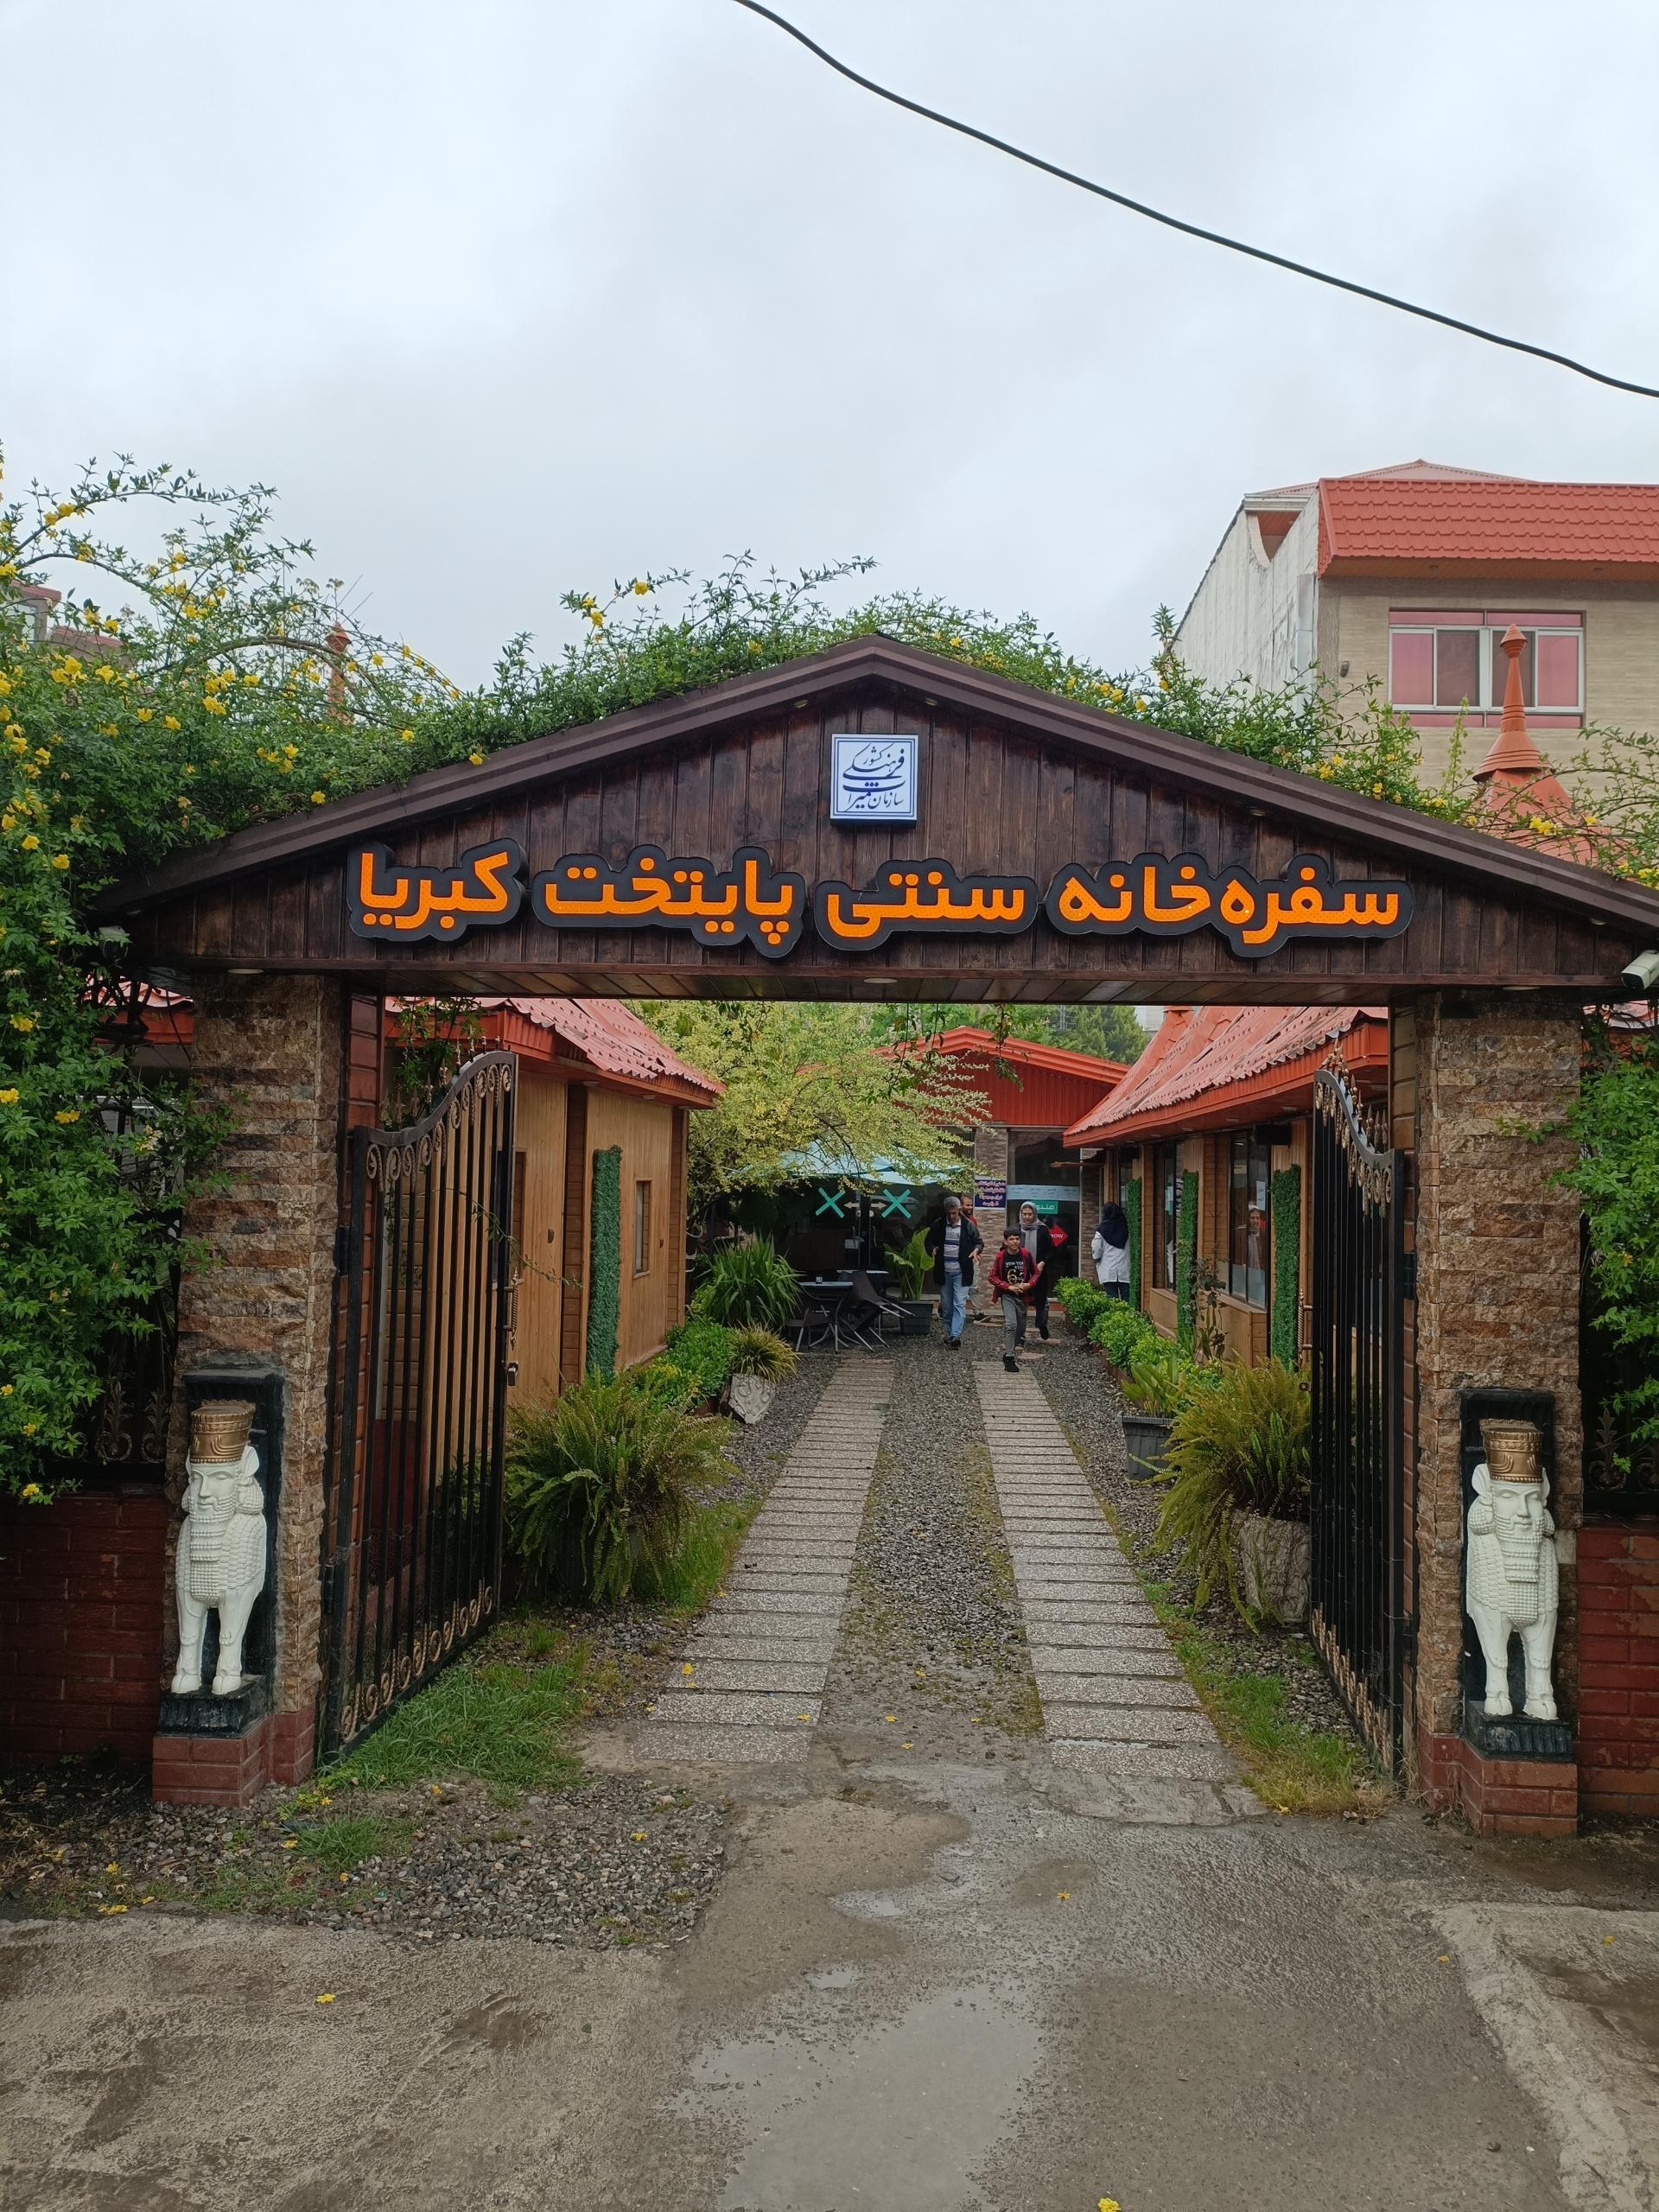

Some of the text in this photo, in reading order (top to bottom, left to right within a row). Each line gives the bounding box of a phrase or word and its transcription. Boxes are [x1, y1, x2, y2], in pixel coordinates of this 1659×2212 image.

[867, 791, 904, 810] سازمان
[361, 852, 508, 930] کبریا
[545, 858, 792, 944] پایتخت
[828, 872, 1024, 938] سنتی
